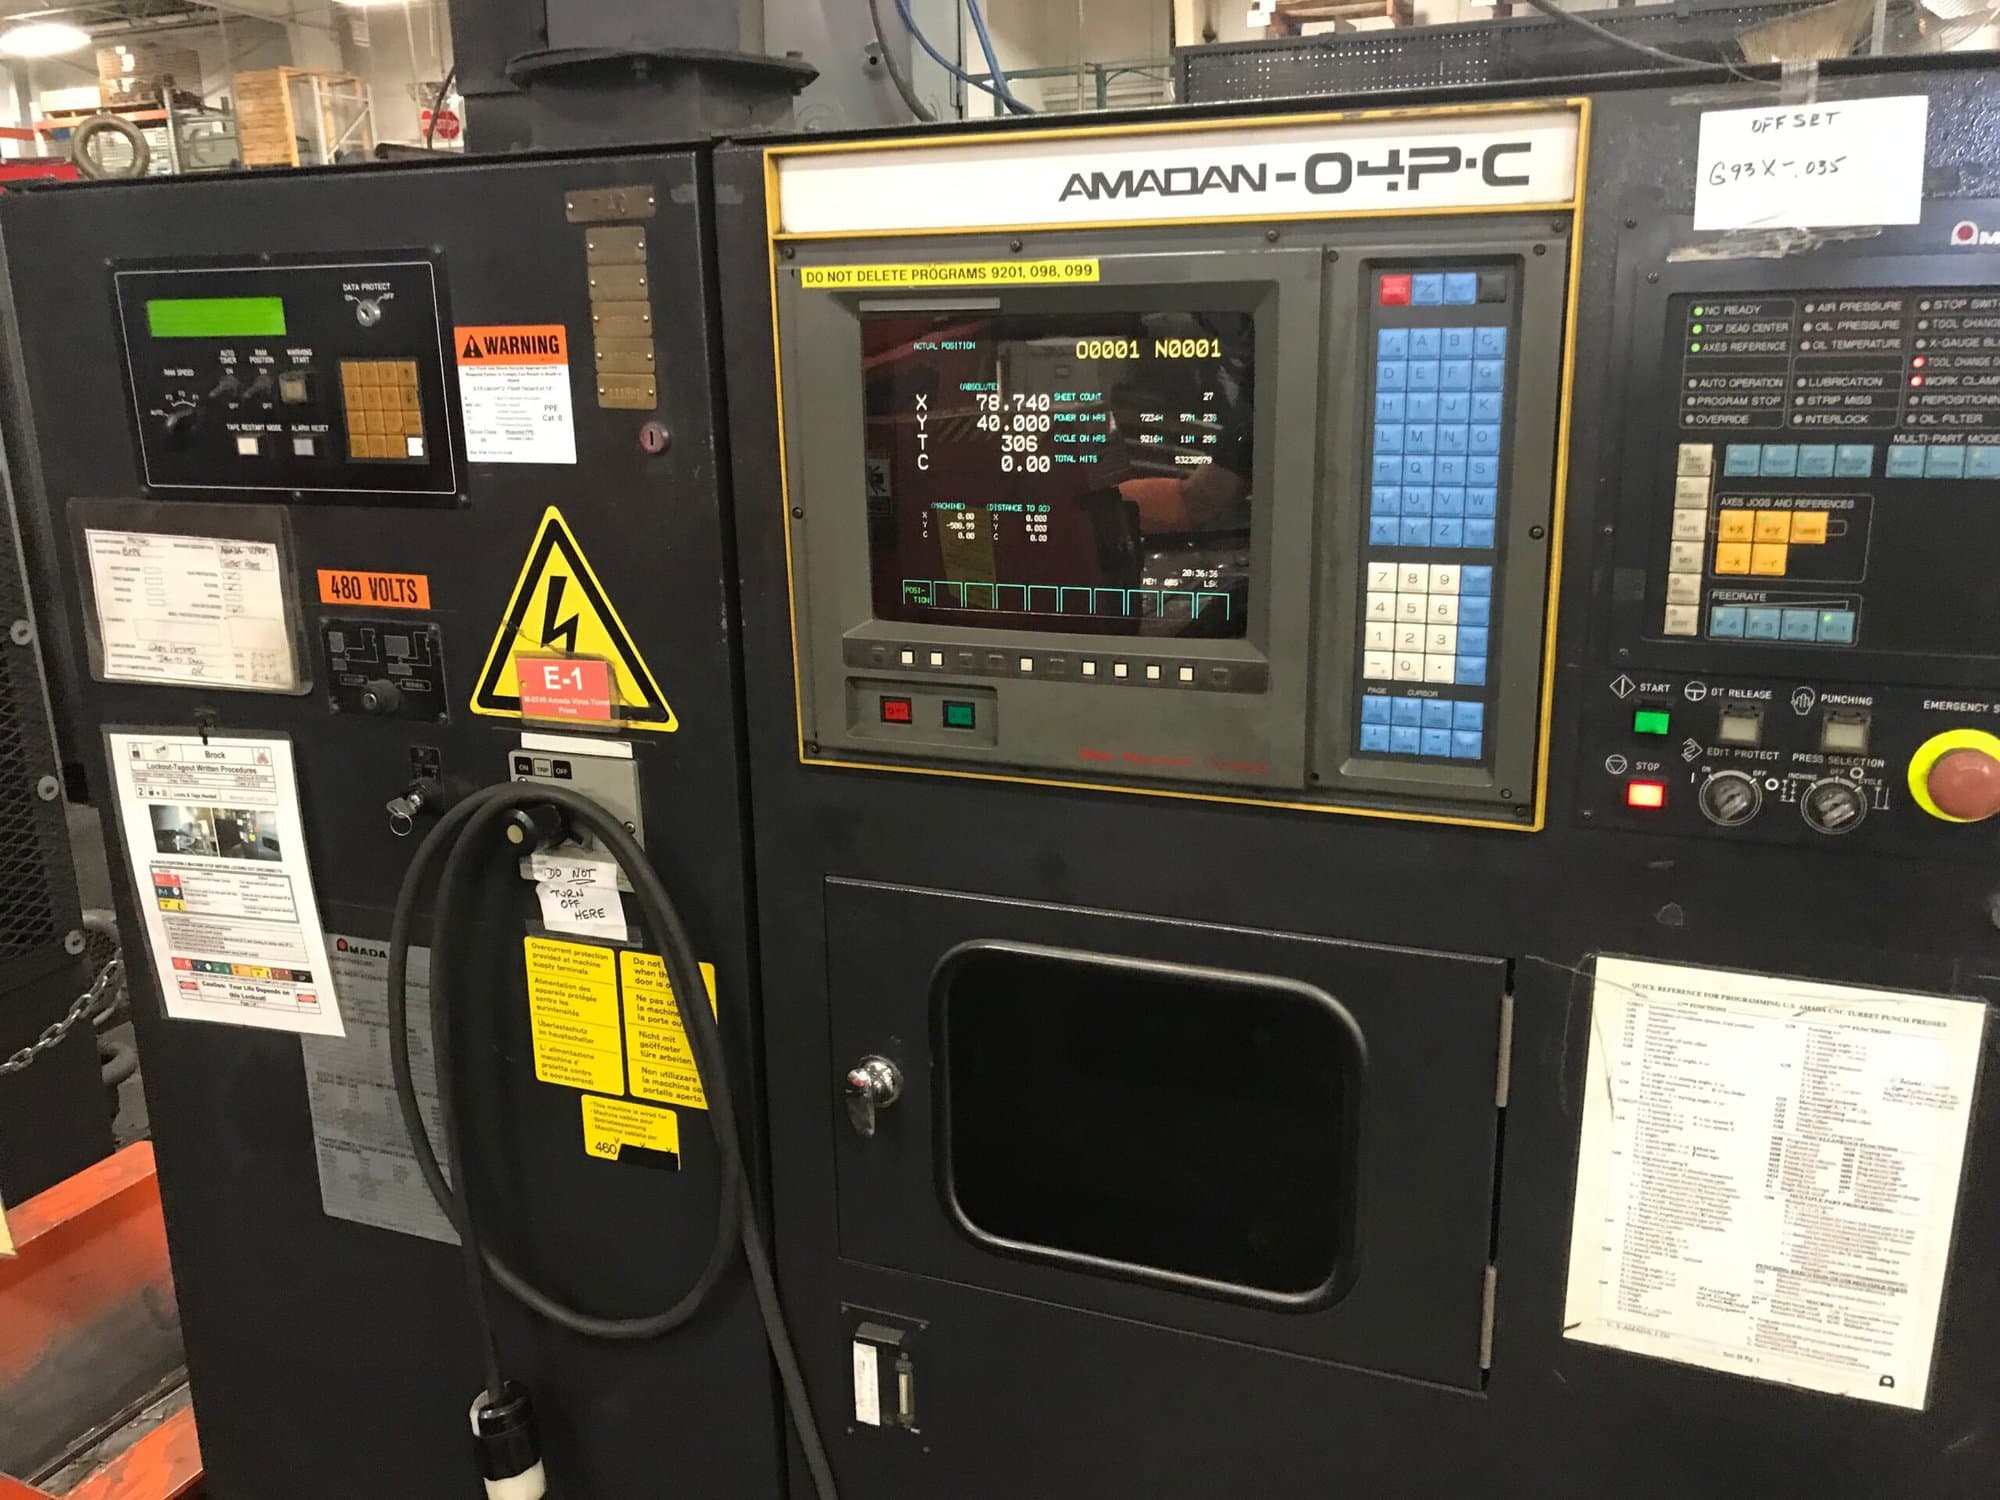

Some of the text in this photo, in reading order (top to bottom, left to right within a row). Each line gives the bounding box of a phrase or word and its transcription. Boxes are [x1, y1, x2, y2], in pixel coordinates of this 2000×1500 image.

[1751, 112, 1841, 134] OFFSET
[806, 264, 1093, 283] DO NOT DELETE PROGRAMS 9201, 098, 099
[361, 282, 391, 291] PROTECT
[1723, 305, 1762, 316] READY
[1816, 300, 1903, 312] AIR PRESSURE
[1933, 300, 1968, 310] STOP
[1705, 322, 1789, 334] TOP DEAD CENTER
[1815, 320, 1901, 331] OIL PRESSURE
[1931, 319, 1959, 329] TOOL
[484, 335, 560, 355] WARNING
[913, 341, 976, 350] ACTUAL POSITION
[1702, 341, 1787, 352] AXES REFERENCE
[1812, 338, 1901, 350] OIL TEMPERATURE
[1929, 338, 1980, 348] X-GAUGE
[1928, 357, 1991, 367] TOOL CHANGE
[1699, 377, 1784, 388] AUTO OPERATION
[1808, 377, 1883, 387] LUBRICATION
[1054, 391, 1214, 401] SHEET COUNT 27
[1696, 396, 1782, 406] PROGRAM STOP
[1807, 395, 1873, 405] STRIP MISS
[916, 393, 1050, 411] X 78.740
[916, 414, 1050, 432] Y 40.000
[1695, 414, 1750, 424] OVERRIDE
[1805, 414, 1870, 424] INTERLOCK
[1919, 414, 1983, 424] OIL FILTER
[917, 434, 1038, 452] T 306
[1054, 434, 1076, 443] CYCLE
[1893, 434, 1963, 444] MULTI-PART
[917, 454, 1051, 472] C 0.00
[1720, 497, 1855, 509] AXES JOGS AND REFERENCES
[1378, 572, 1387, 582] 7
[1407, 572, 1418, 584] 8
[1439, 573, 1450, 585] 9
[330, 575, 418, 604] 480 VOLTS
[905, 586, 925, 595] POSI-
[1711, 591, 1767, 602] FEEDRATE
[1375, 601, 1385, 612] 4
[1406, 602, 1416, 613] 5
[1437, 604, 1448, 615] 6
[1375, 632, 1382, 641] 1
[1405, 632, 1415, 644] 2
[1436, 634, 1446, 645] 3
[543, 665, 583, 691] E-1
[1367, 686, 1387, 694] PAGE
[1407, 689, 1438, 697] CURSOR
[1639, 683, 1671, 693] START
[1729, 688, 1772, 700] RELEASE
[1820, 693, 1873, 706] PUNCHING
[1923, 699, 1989, 713] EMERGENCY
[204, 750, 226, 759] Brock
[1706, 747, 1780, 761] EDIT PROTECT
[1792, 753, 1885, 768] PRESS SELECTION
[146, 763, 257, 774] Lockout-Tagout Written Procedures
[1635, 761, 1660, 772] STOP
[1830, 768, 1845, 776] OFF
[1858, 778, 1883, 786] CYCLE
[546, 868, 597, 879] DO NOT
[550, 888, 584, 898] TURN
[560, 899, 581, 909] OFF
[575, 908, 606, 921] HERE
[531, 942, 609, 961] Overcurrent protection
[532, 952, 601, 968] provided at machine
[633, 957, 662, 969] Do not
[533, 961, 588, 976] supply terminals
[634, 968, 656, 978] when
[635, 977, 663, 989] door is
[636, 994, 664, 1007] Ne pas
[1631, 982, 1655, 991] QUICK
[1657, 985, 1702, 997] REFERENCE
[1704, 990, 1720, 999] FOR
[1721, 992, 1781, 1008] PROGRAMMING
[1847, 1010, 1879, 1020] TURRET
[1881, 1013, 1910, 1024] PUNCH
[1911, 1017, 1947, 1028] PRESSES
[639, 1030, 676, 1044] Nicht mit
[659, 1054, 692, 1065] arbeiten
[641, 1066, 697, 1084] Non utilizzare
[643, 1085, 702, 1104] portello aperto
